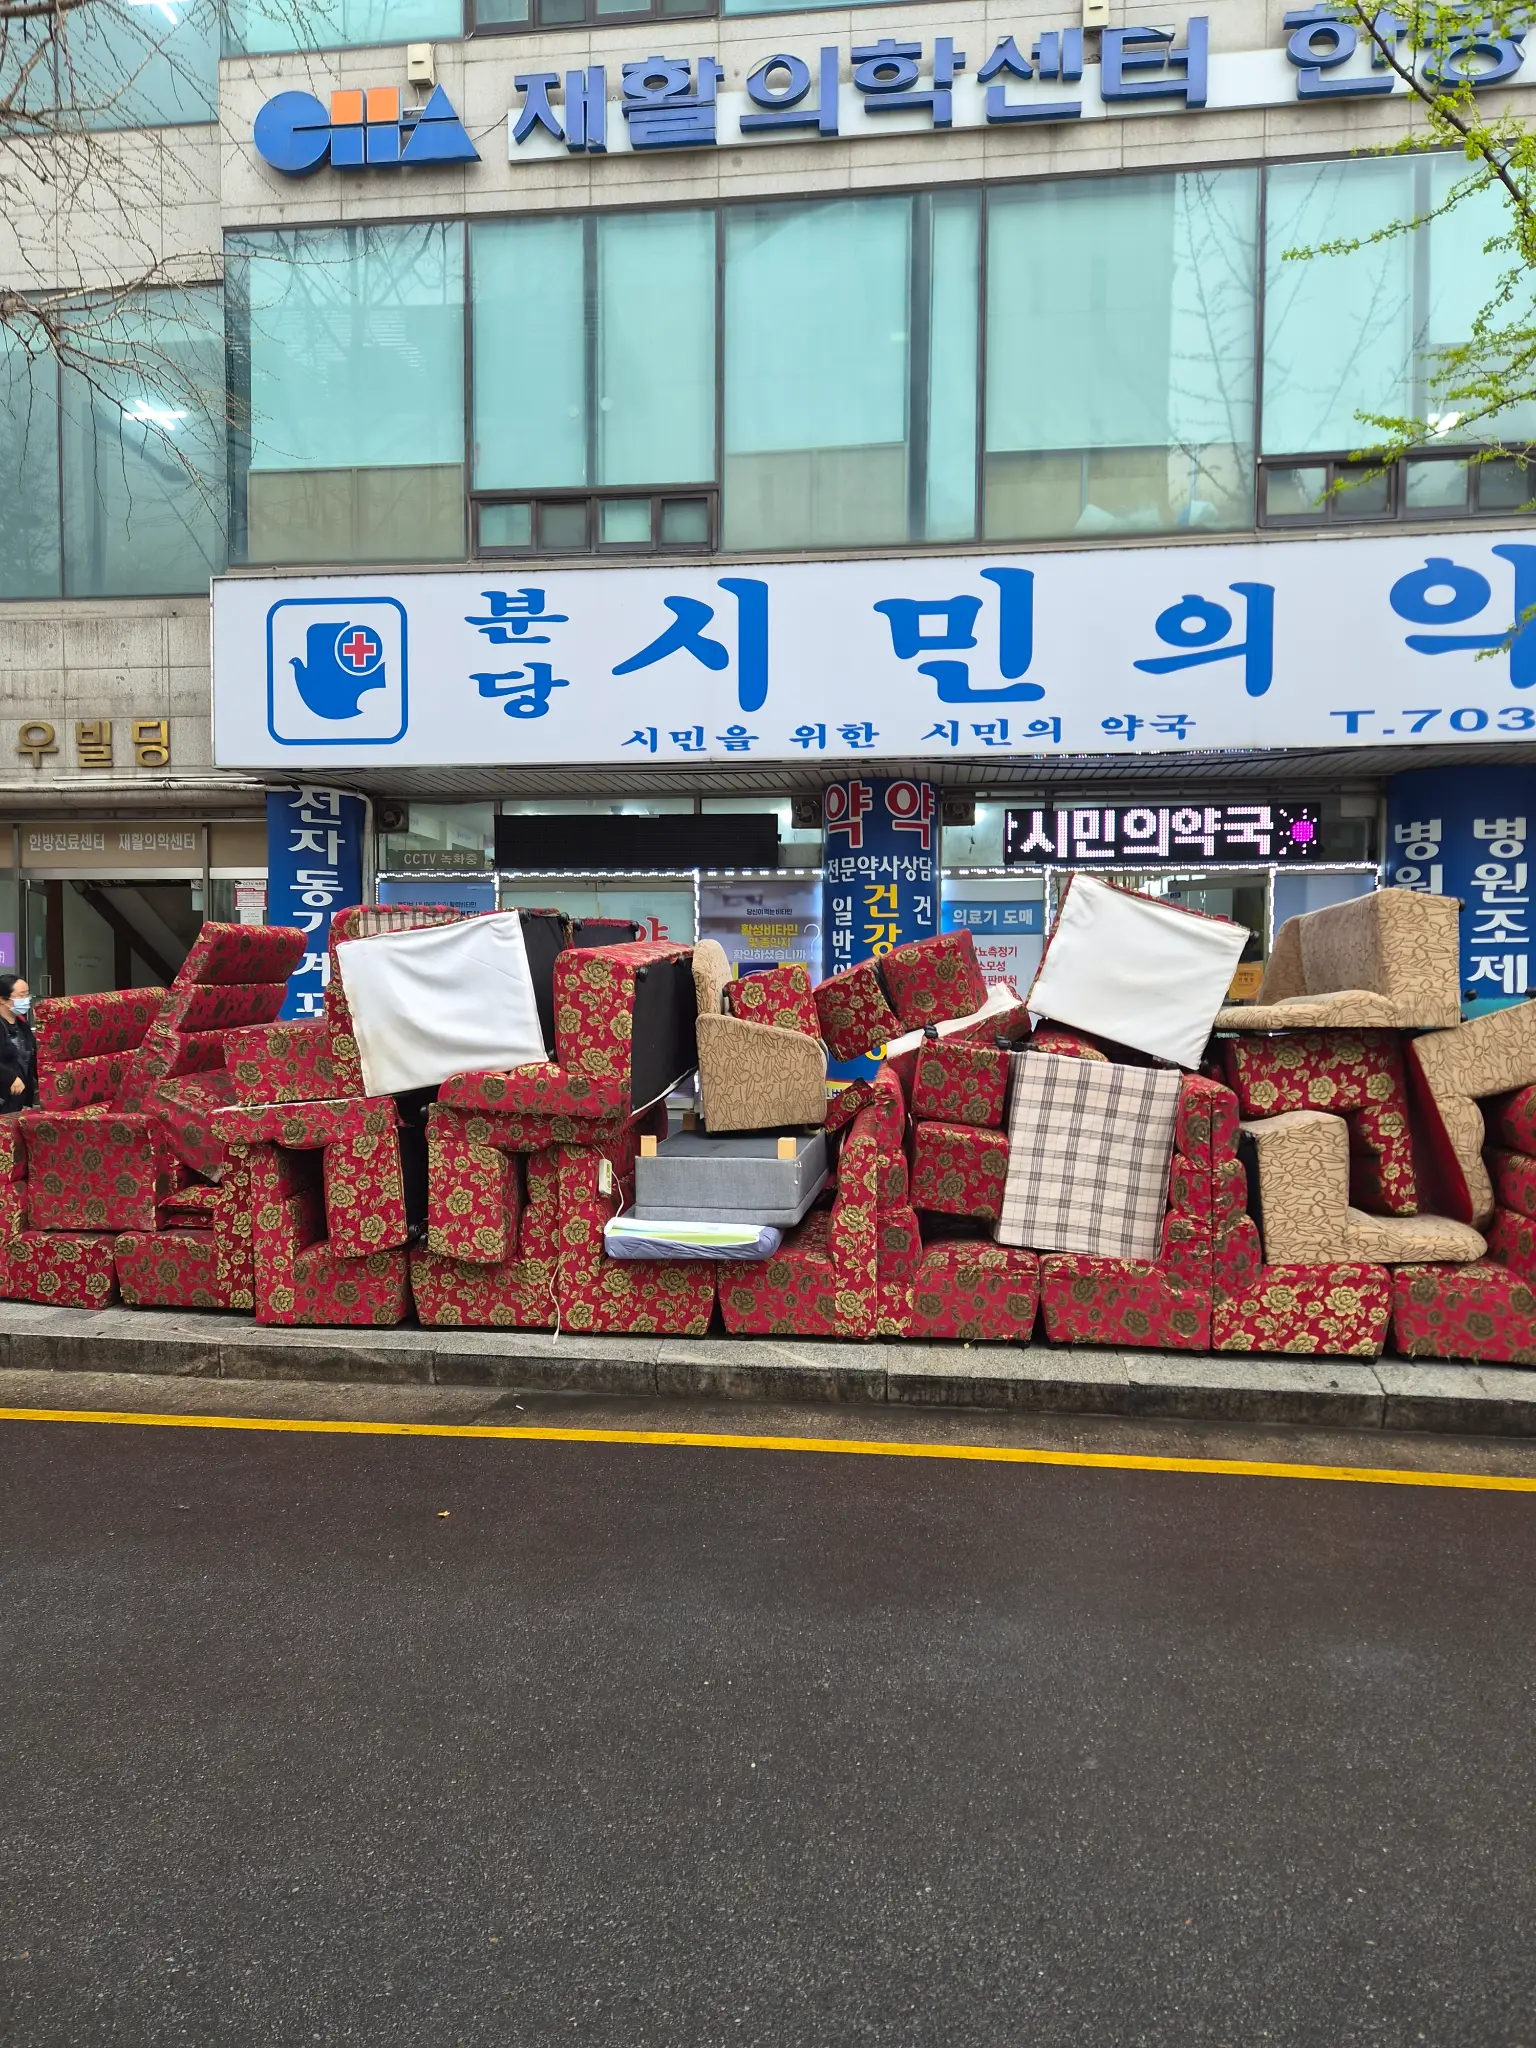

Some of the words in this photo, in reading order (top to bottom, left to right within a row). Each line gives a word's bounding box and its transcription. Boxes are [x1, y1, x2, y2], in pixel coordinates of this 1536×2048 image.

[512, 16, 1208, 152] 재활의학센터
[465, 588, 569, 719] 분당
[15, 720, 170, 768] 우빌딩
[623, 725, 759, 752] 시민을
[790, 722, 879, 750] 위한
[924, 717, 1062, 747] 시민의
[1101, 713, 1195, 741] 약국
[825, 780, 873, 849] 약
[885, 781, 935, 850] 약
[29, 833, 105, 851] 한방진료센터
[118, 833, 196, 851] 재활의학센터
[1008, 807, 1273, 857] 시민의약국
[404, 854, 436, 864] CCTV
[441, 853, 478, 865] 녹화중
[828, 856, 932, 883] 전문약사상담
[746, 908, 763, 916] 당신이
[764, 908, 775, 916] 먹는
[776, 908, 793, 916] 비타민
[953, 909, 997, 926] 의료기
[1003, 909, 1033, 926] 도매
[1466, 816, 1529, 993] 병원조제
[740, 923, 798, 936] 활성비타민
[748, 937, 758, 948] 몇
[759, 937, 791, 948] 종인지
[733, 949, 807, 960] 확인하셨습니까
